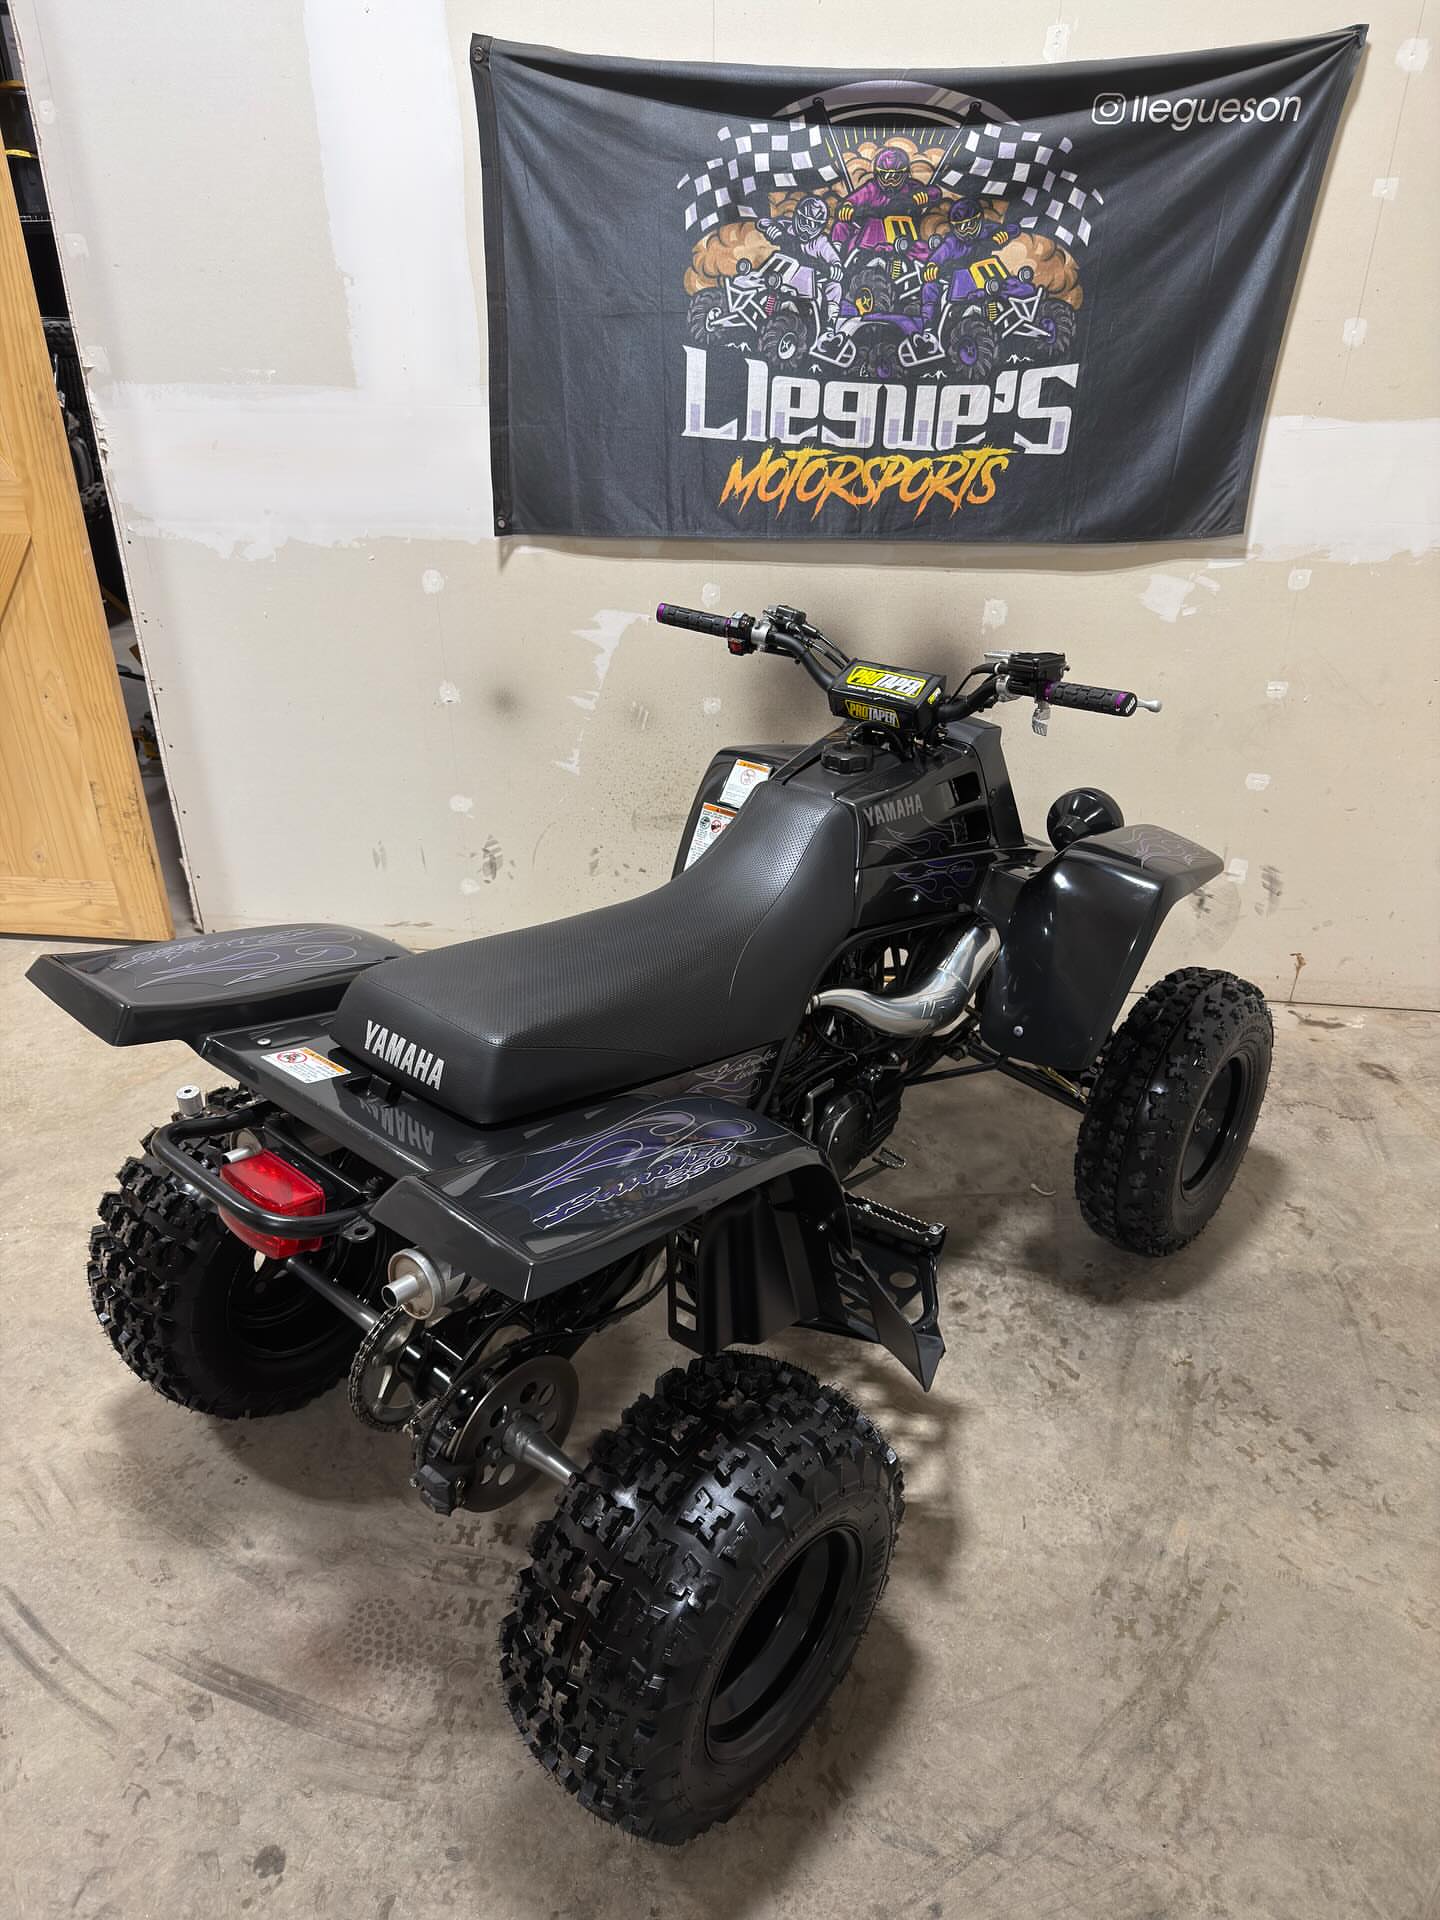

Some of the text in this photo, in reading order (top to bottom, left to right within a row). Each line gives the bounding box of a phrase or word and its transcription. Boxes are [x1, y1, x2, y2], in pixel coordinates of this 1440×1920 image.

[1131, 96, 1302, 131] llegueson
[718, 443, 1024, 521] MOTORSPORTS
[863, 794, 923, 827] YAMAHA
[364, 1020, 445, 1090] YAMAHA
